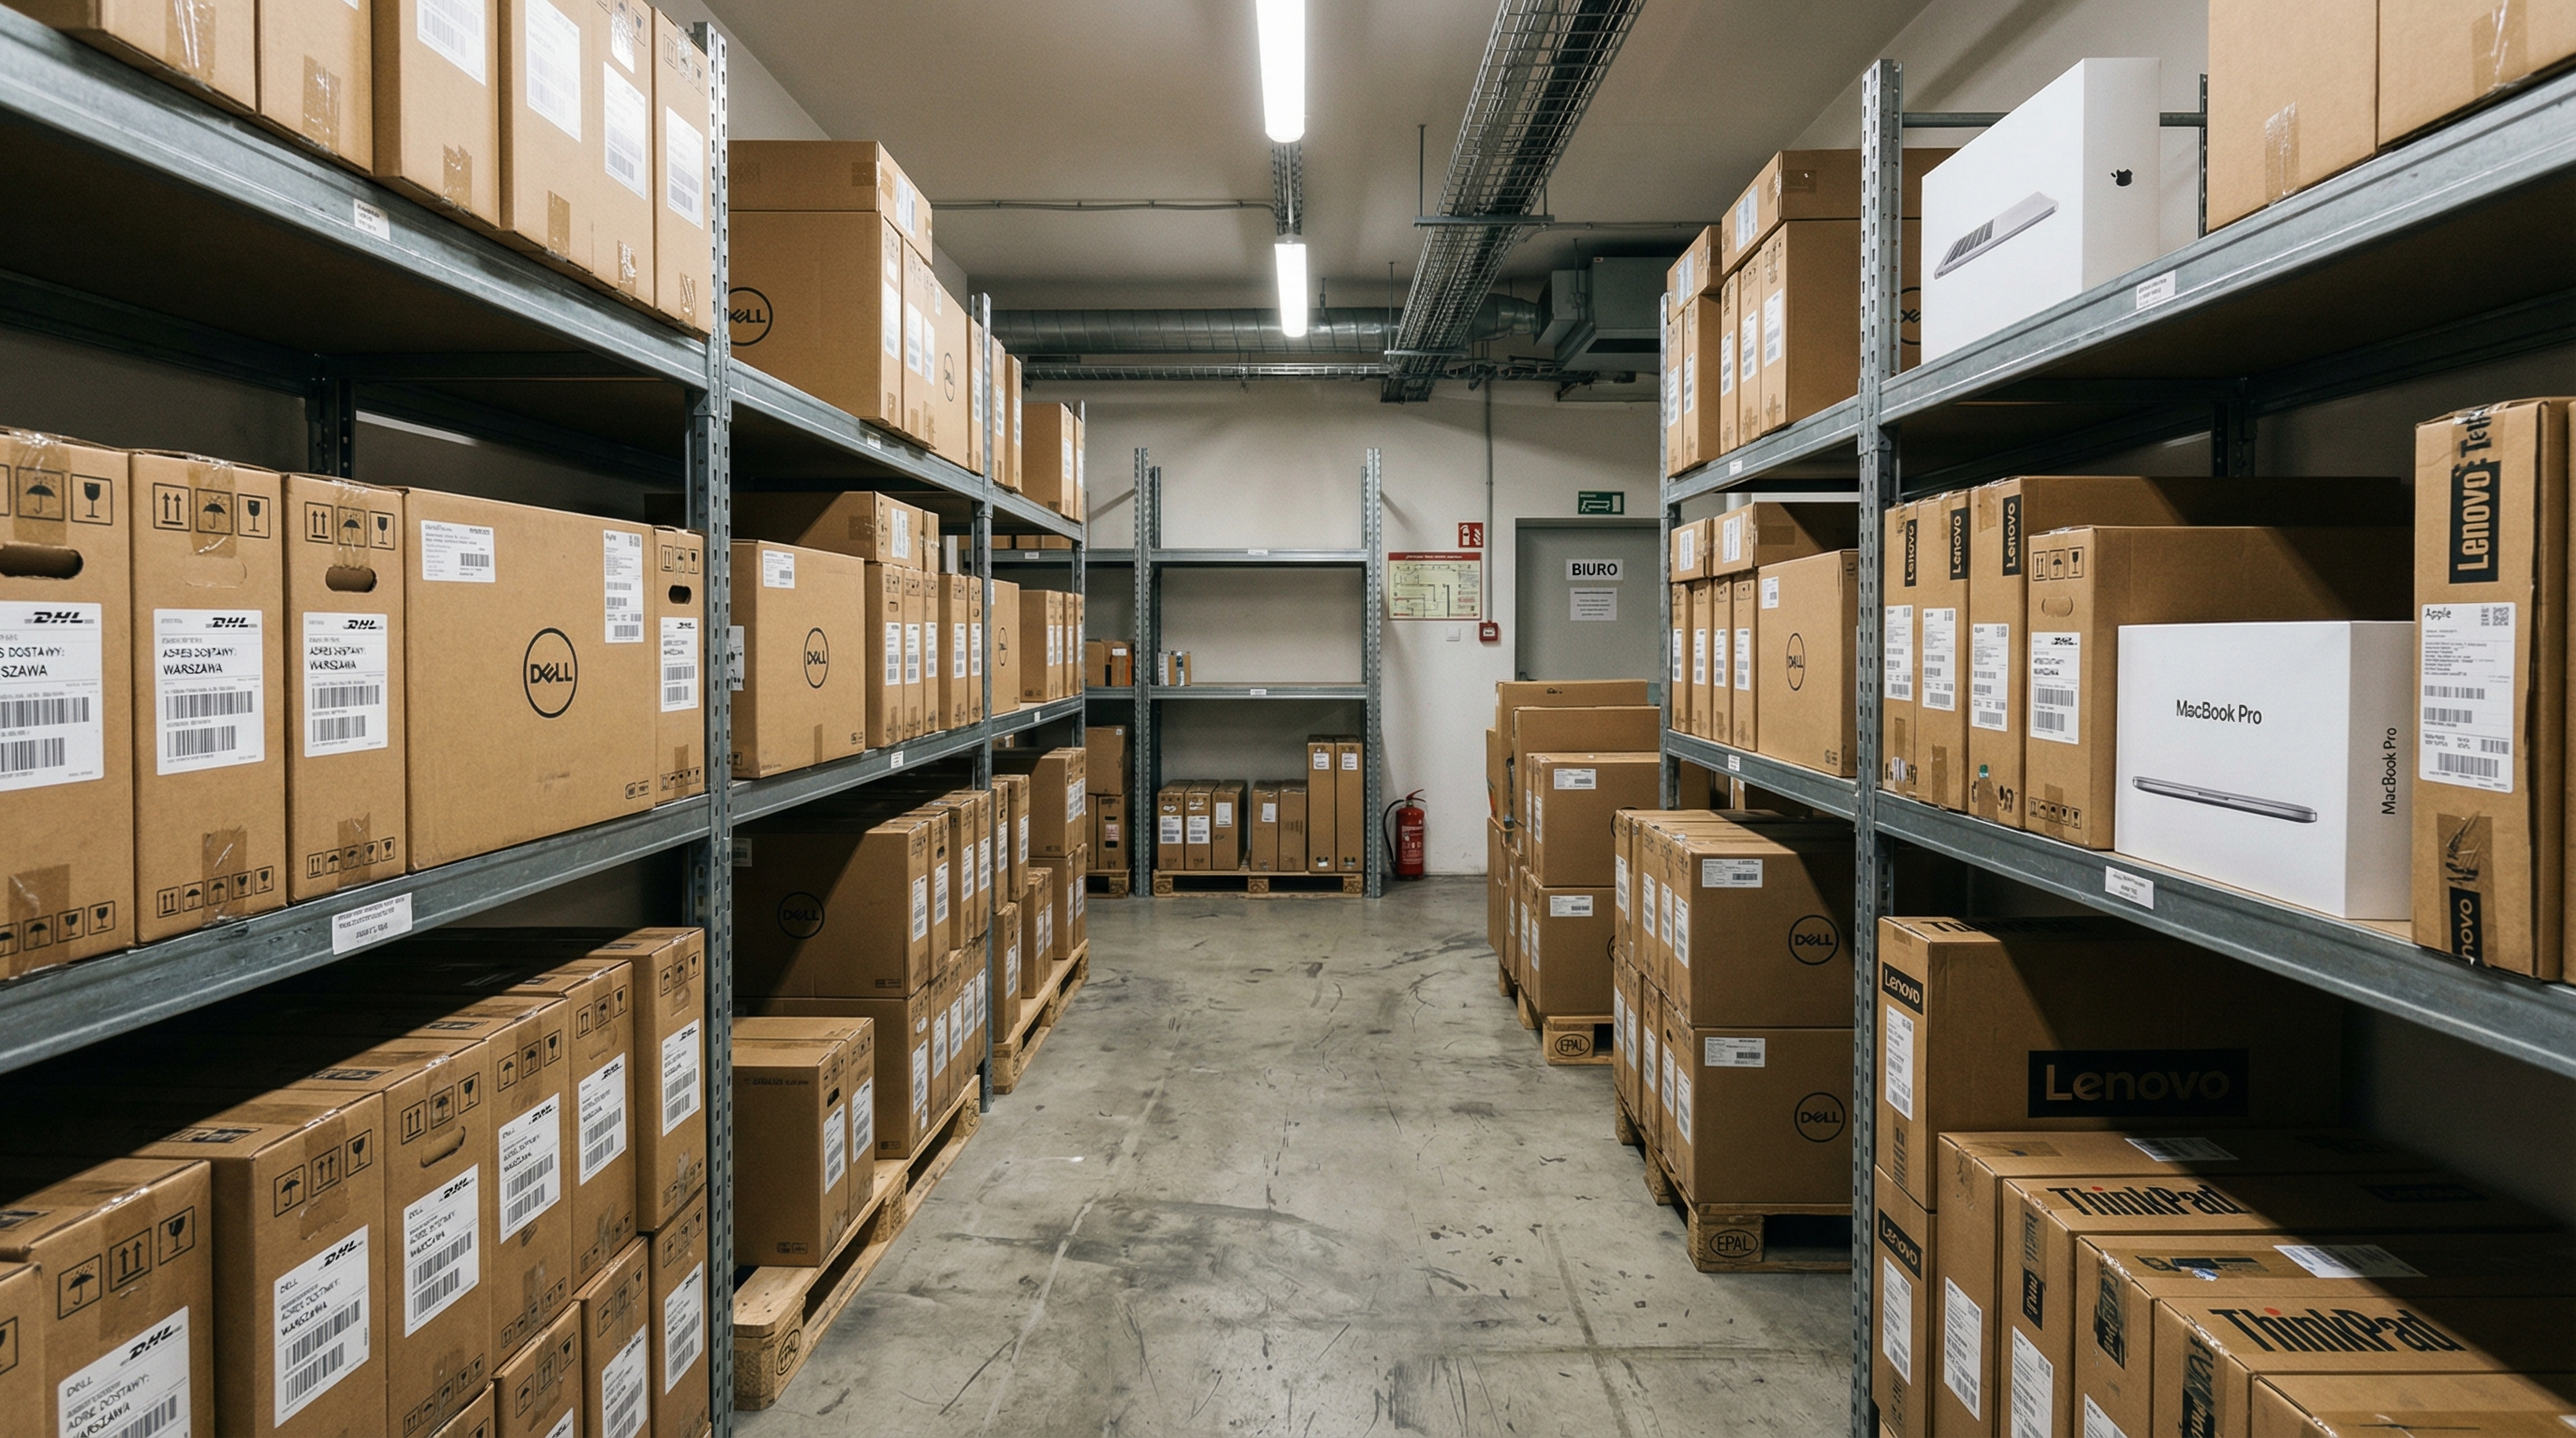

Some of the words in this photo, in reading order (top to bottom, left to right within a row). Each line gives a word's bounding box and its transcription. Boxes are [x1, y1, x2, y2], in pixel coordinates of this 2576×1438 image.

[2006, 502, 2016, 567] Lenovo
[2457, 470, 2491, 571] Lenovo
[1953, 515, 1962, 574] Lenovo
[1572, 563, 1618, 576] BIURO
[33, 611, 83, 624] DHL
[212, 617, 249, 628] DHL
[0, 664, 48, 678] SZAWA
[530, 661, 573, 683] DELL
[2176, 698, 2235, 723] MacBook
[2238, 704, 2262, 726] Pro
[2383, 727, 2397, 750] Pro
[2381, 752, 2397, 814] MacBook
[783, 908, 820, 921] DELL
[1794, 933, 1834, 946] DELL
[2459, 899, 2474, 959] novo
[1884, 968, 1921, 1005] Lenovo
[1560, 1038, 1585, 1052] EPAL
[2045, 1064, 2230, 1101] Lenovo
[1800, 1111, 1841, 1123] DELL
[2045, 1183, 2253, 1216] ThinkPad
[324, 1240, 357, 1268] DHL
[1717, 1235, 1752, 1252] EPAL
[1882, 1220, 1918, 1266] Lenovo
[128, 1325, 174, 1360] DHL
[2207, 1307, 2468, 1352] ThinkPad
